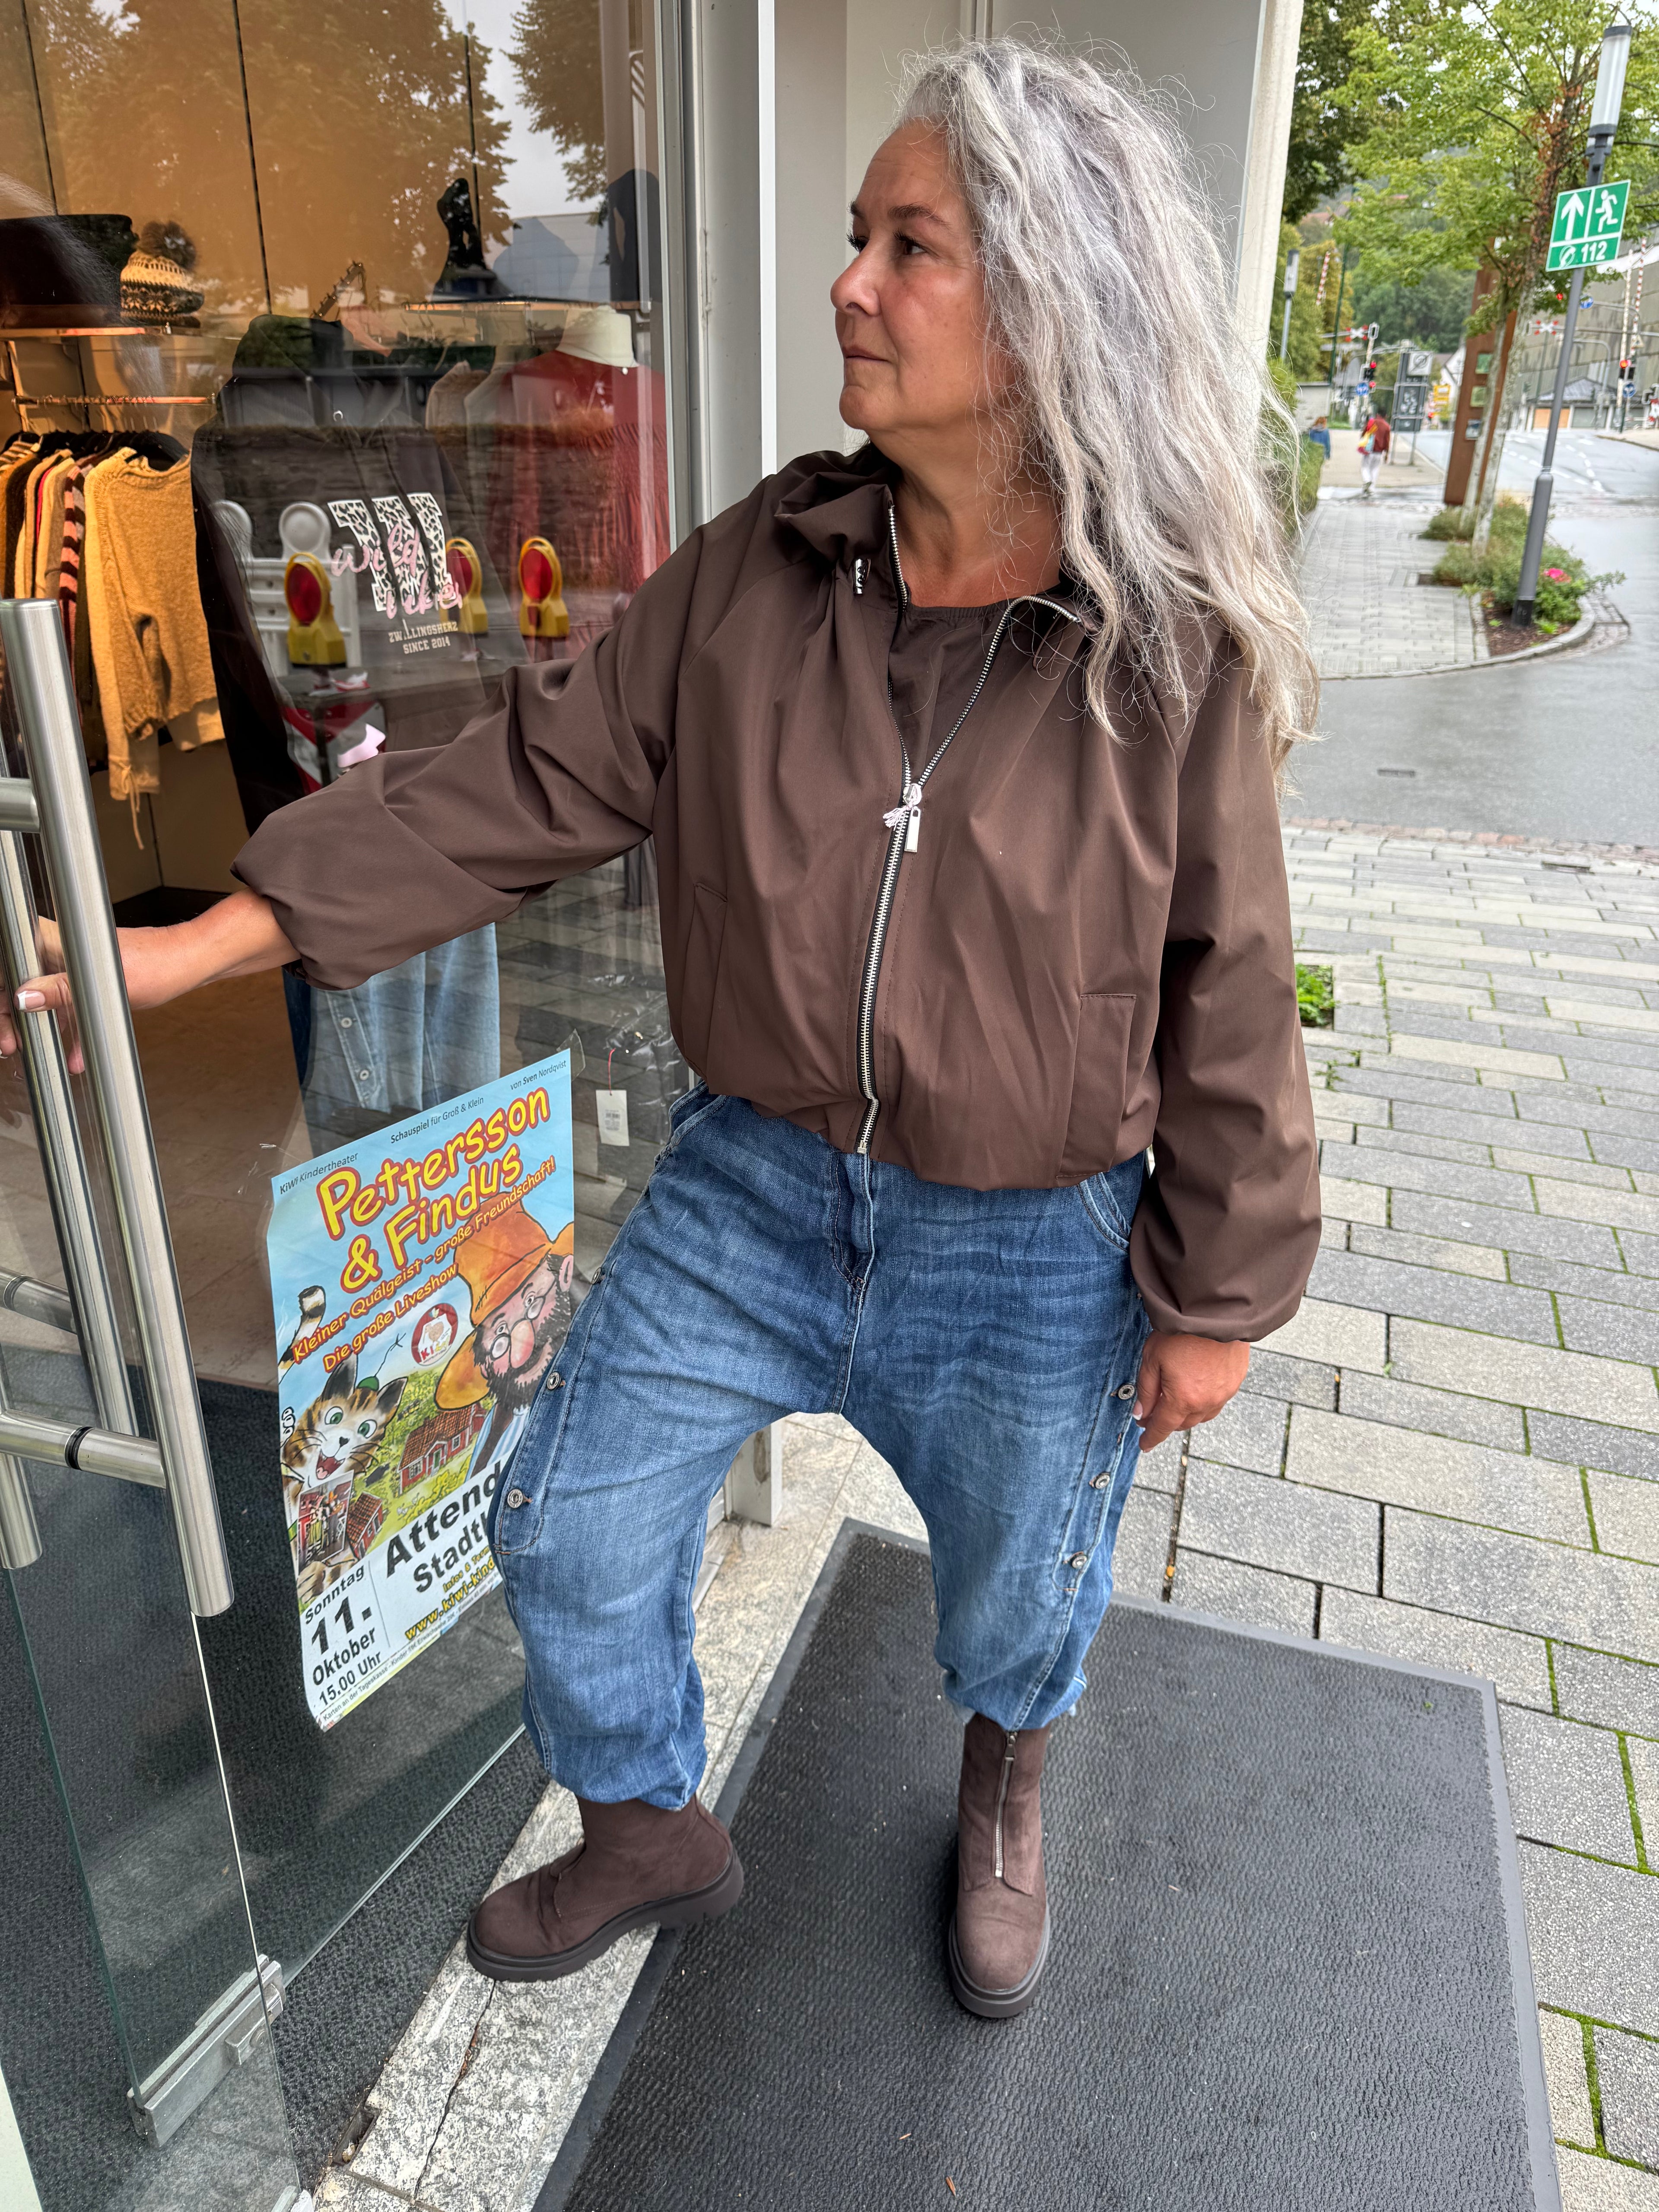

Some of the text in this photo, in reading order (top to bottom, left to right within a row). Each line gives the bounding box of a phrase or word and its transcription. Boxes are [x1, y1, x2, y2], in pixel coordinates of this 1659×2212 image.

[1581, 241, 1608, 263] 112
[403, 636, 451, 654] SINCE 2014
[510, 1060, 566, 1090] von Sven Nordqvist
[391, 1096, 484, 1144] Schauspiel für Groß & Klein
[280, 1153, 359, 1195] KiWi Kindertheater
[317, 1087, 550, 1240] Pettersson
[340, 1144, 524, 1293] & Findus
[292, 1312, 349, 1364] Kleiner
[350, 1258, 422, 1319] Quälgeist
[435, 1225, 475, 1264] große
[475, 1155, 556, 1232] Freundschaft!
[323, 1262, 459, 1373] Die große Liveshow
[387, 1460, 501, 1579] Attend
[305, 1565, 365, 1625] Sonntag
[405, 1555, 495, 1640] www.kiwi-kind
[311, 1596, 372, 1656] 11.
[313, 1627, 376, 1686] Oktober
[319, 1651, 381, 1706] 15.00 Uhr
[323, 1704, 342, 1721] Karten
[342, 1698, 350, 1707] an
[350, 1691, 358, 1700] der
[359, 1666, 388, 1692] Tageskasse
[391, 1650, 408, 1666] Kinder
